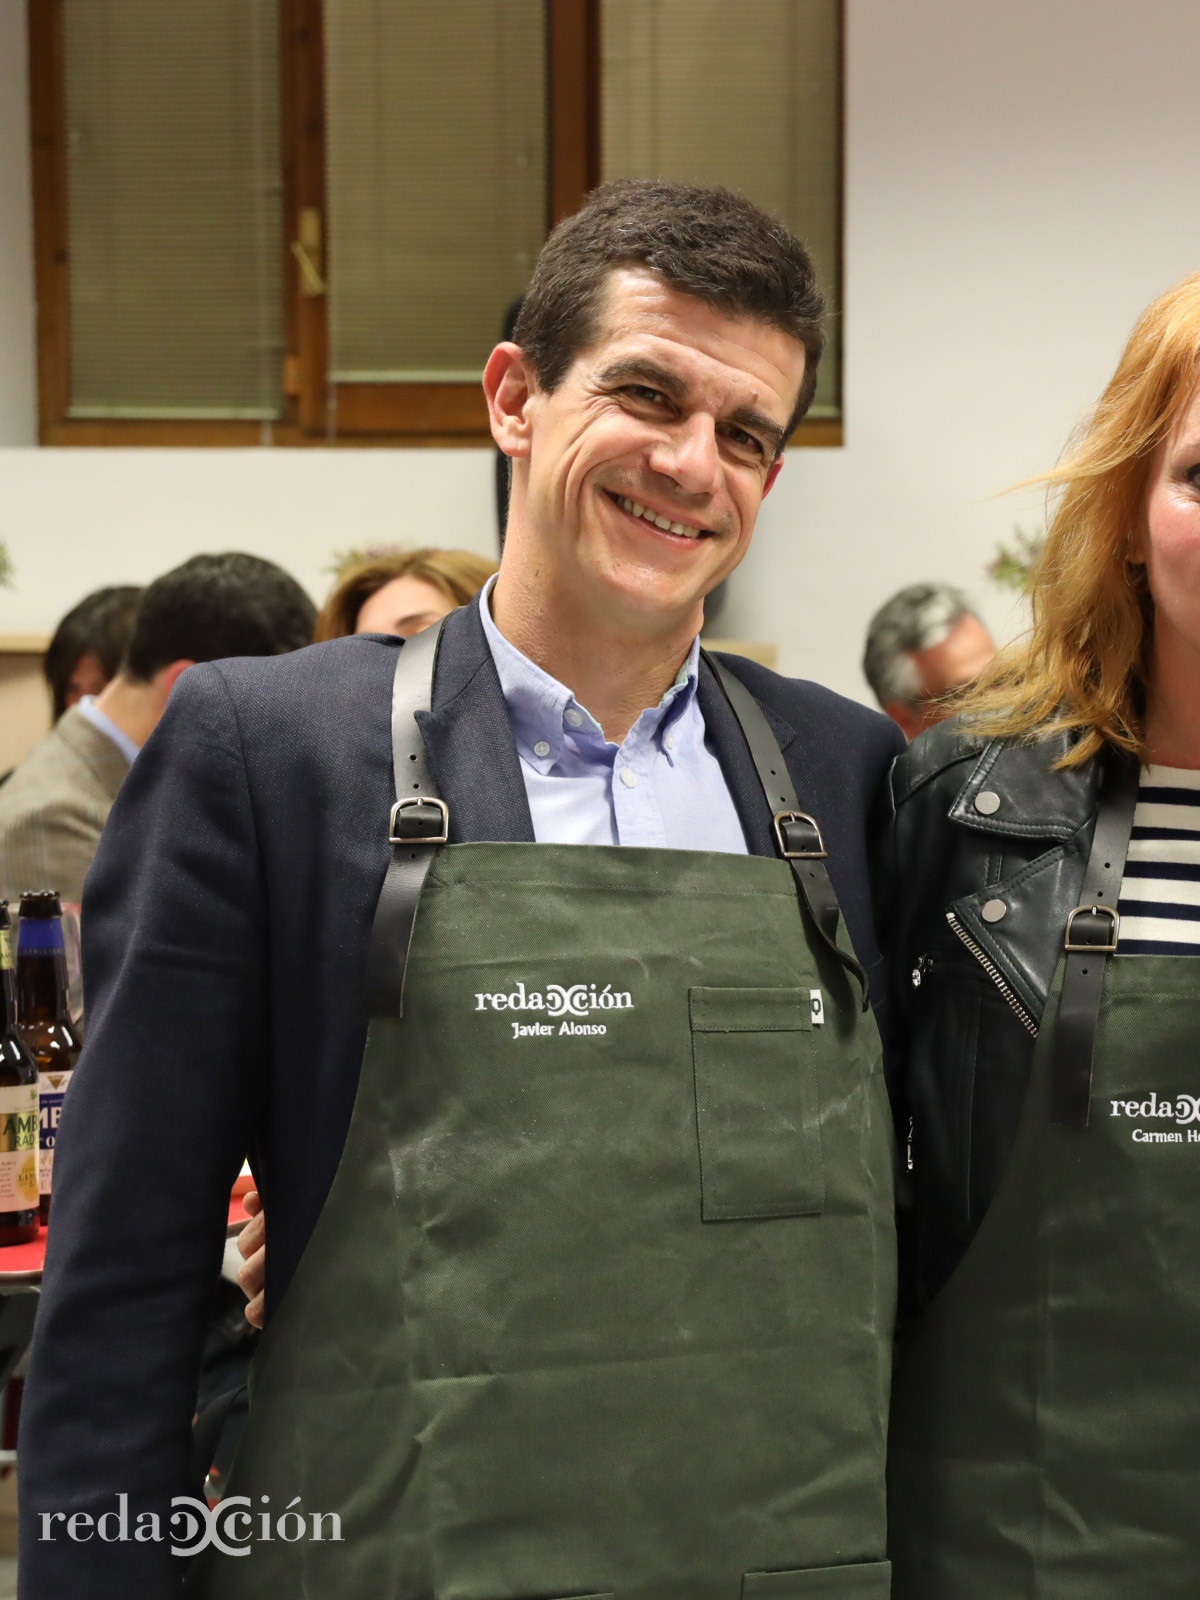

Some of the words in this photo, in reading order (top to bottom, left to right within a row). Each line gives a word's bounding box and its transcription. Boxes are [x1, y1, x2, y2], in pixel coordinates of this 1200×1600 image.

[511, 1022, 555, 1039] Javier
[558, 1021, 607, 1036] Alonso
[1132, 1128, 1183, 1143] Carmen
